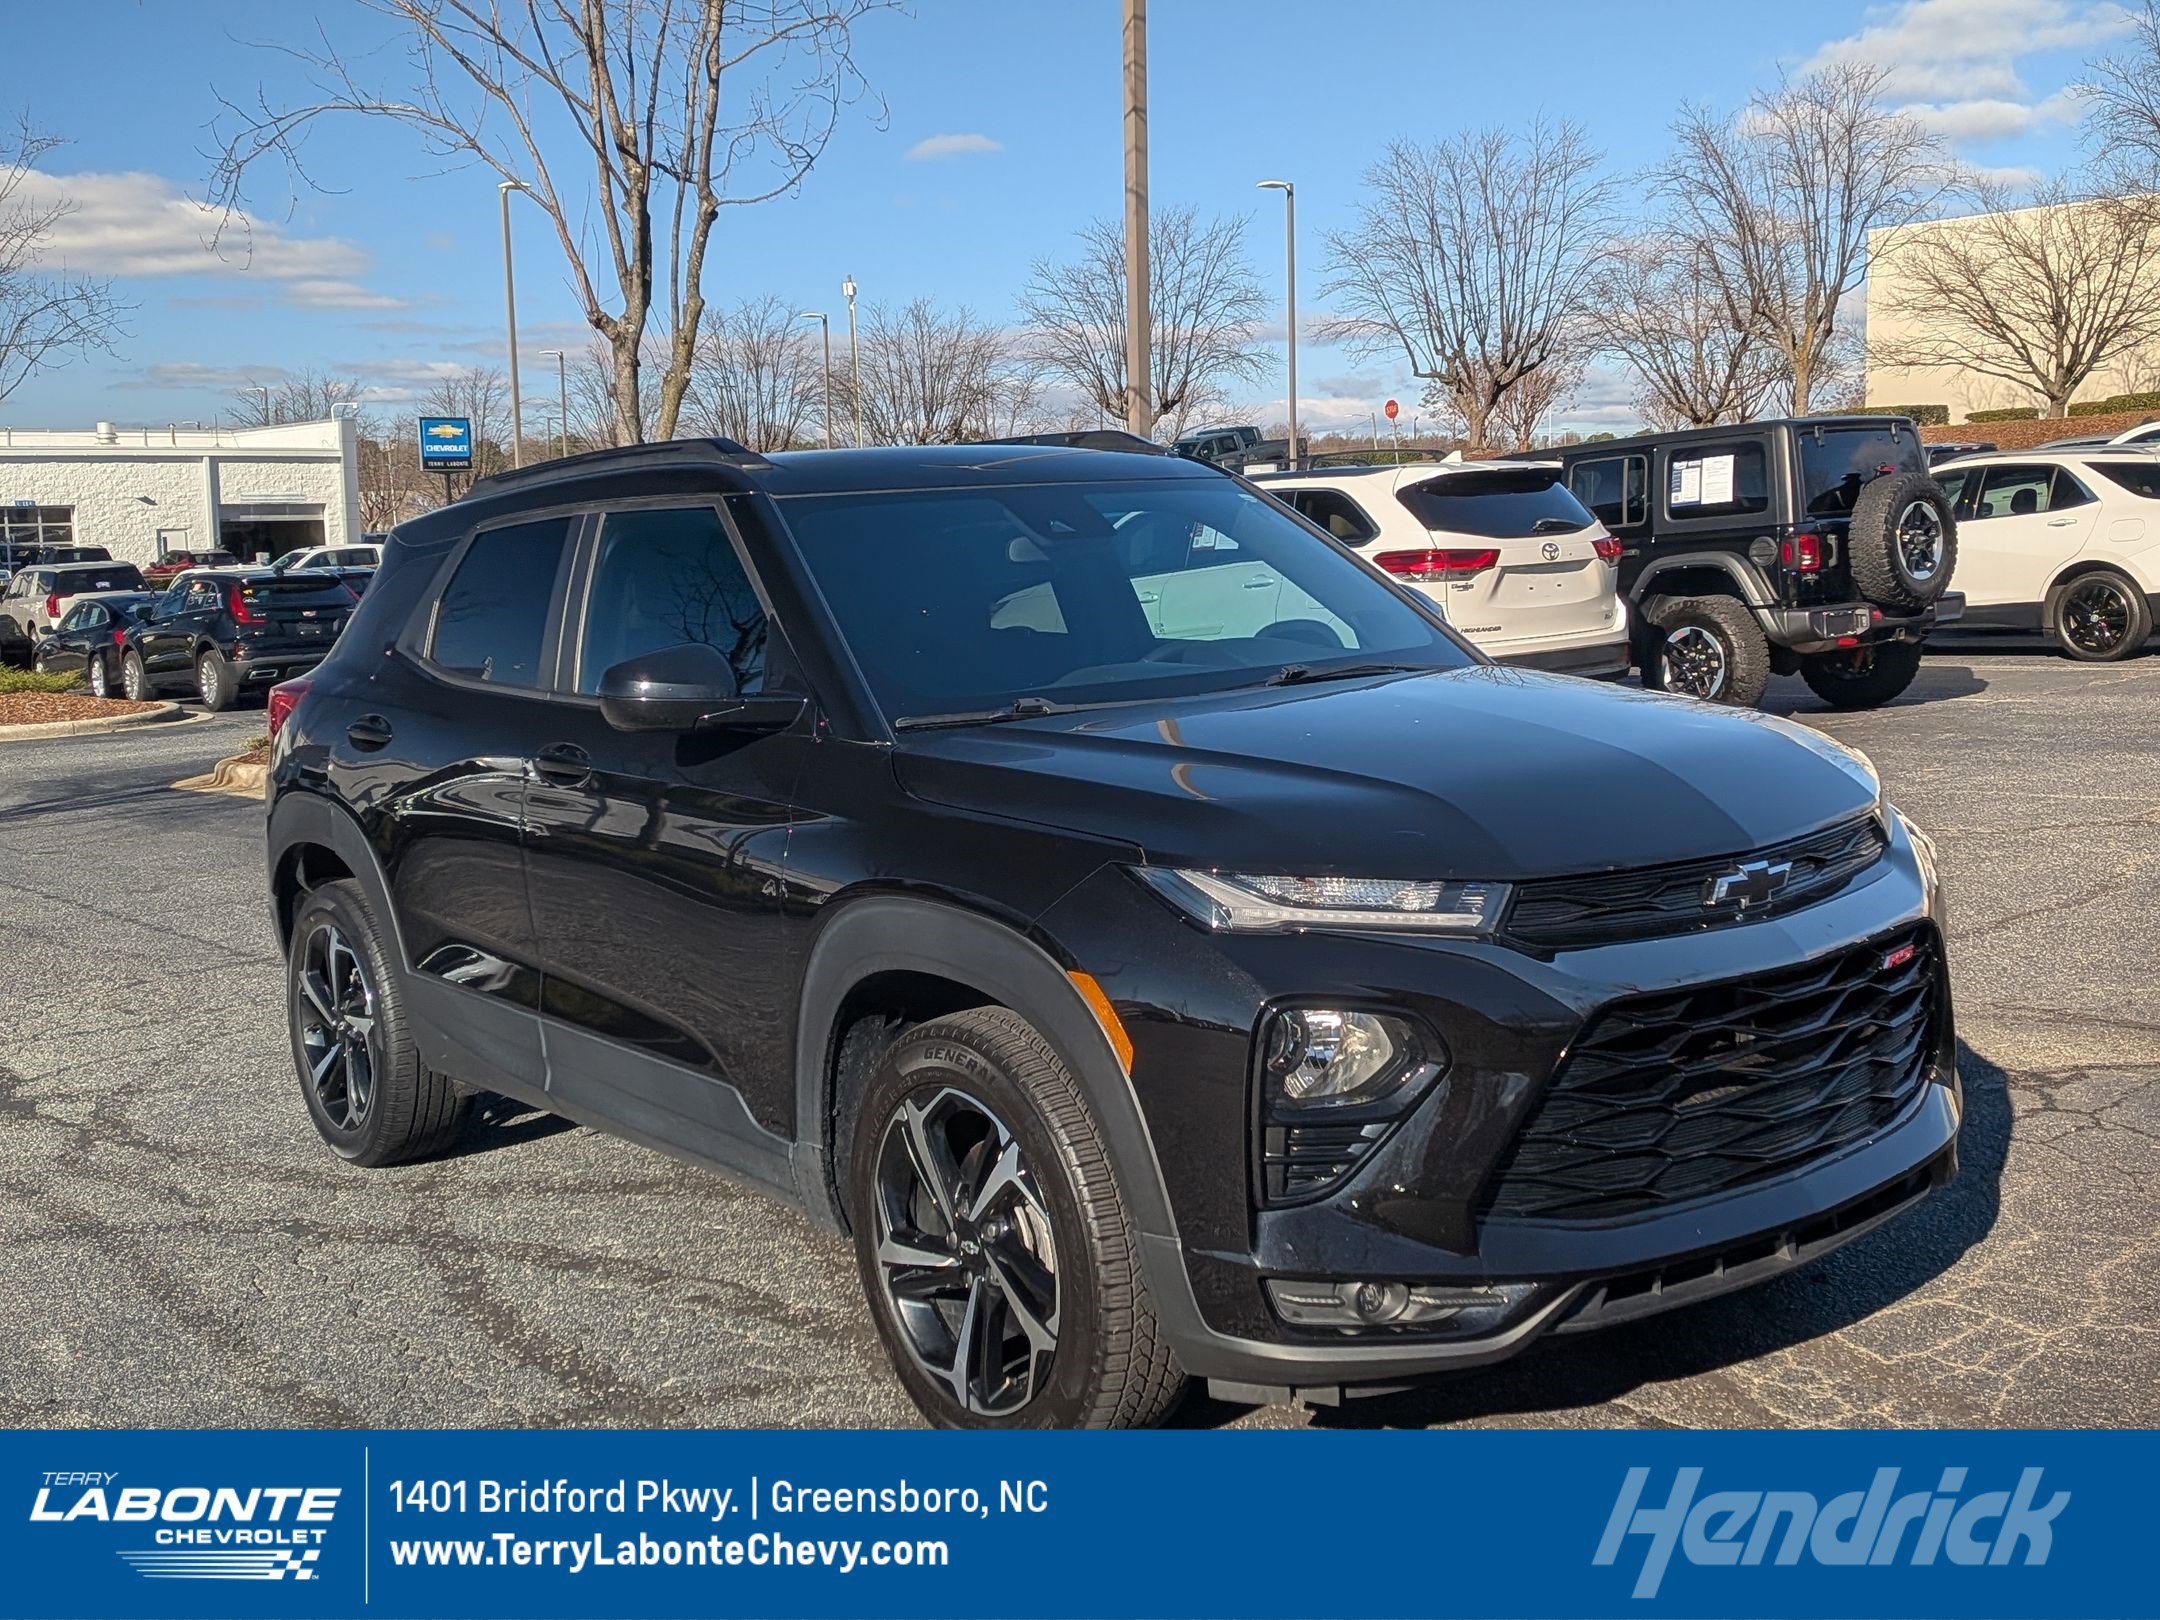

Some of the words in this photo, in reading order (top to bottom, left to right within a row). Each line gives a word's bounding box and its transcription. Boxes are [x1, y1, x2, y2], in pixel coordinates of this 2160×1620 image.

[425, 444, 468, 452] CHEVROLET
[1460, 625, 1502, 634] HIGHLANDER
[1888, 944, 1915, 969] RS
[923, 1046, 997, 1085] GENERAL
